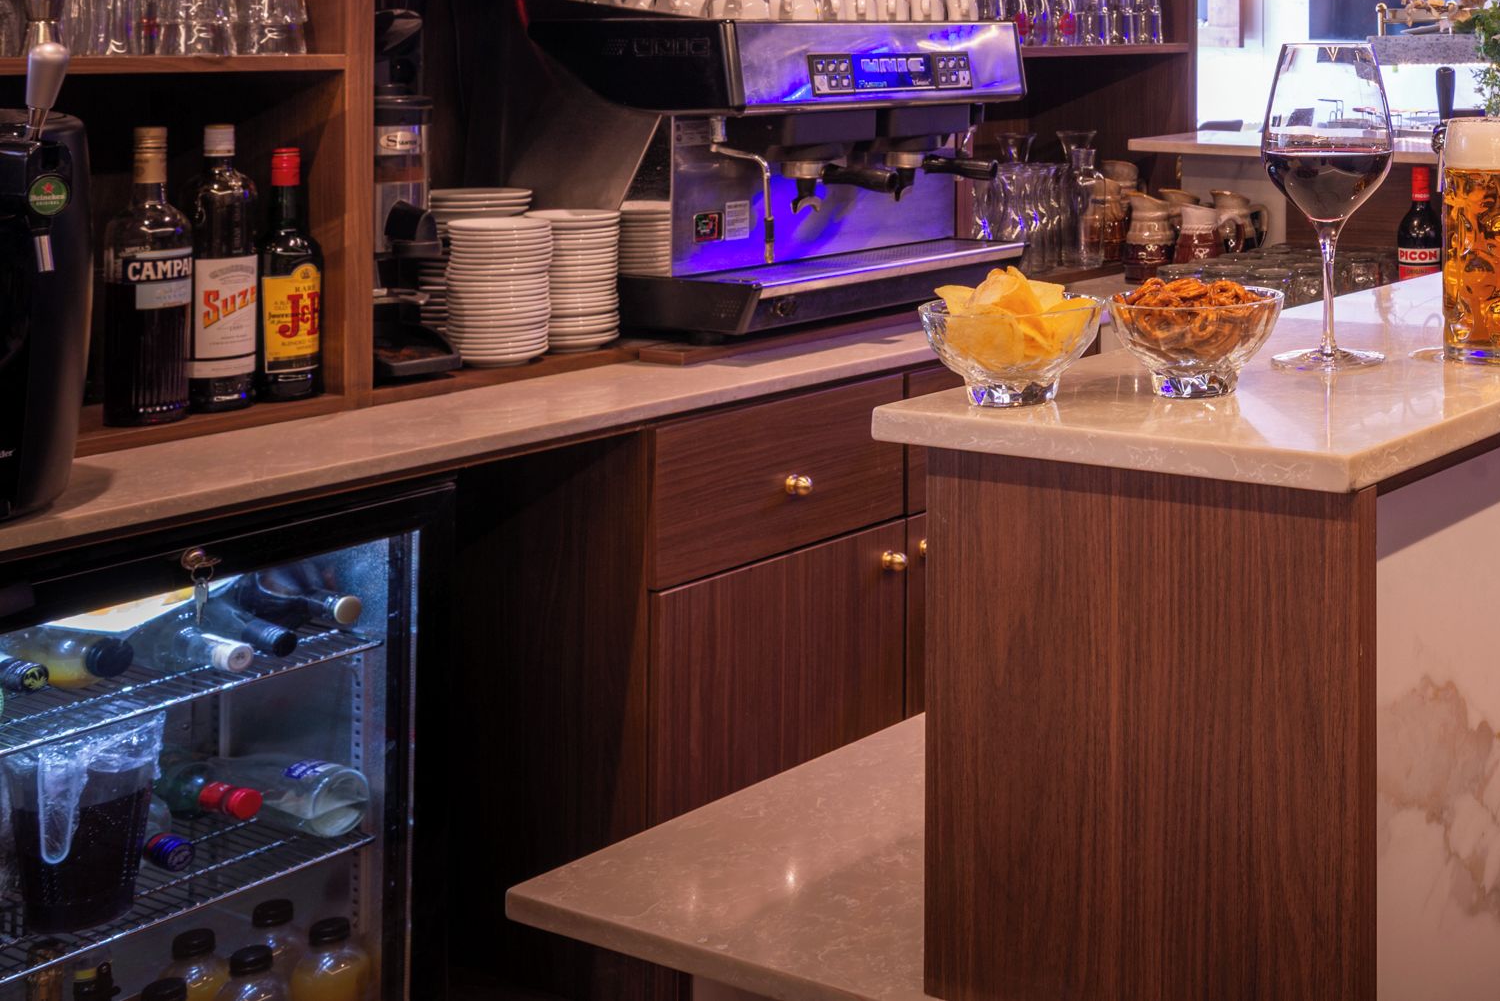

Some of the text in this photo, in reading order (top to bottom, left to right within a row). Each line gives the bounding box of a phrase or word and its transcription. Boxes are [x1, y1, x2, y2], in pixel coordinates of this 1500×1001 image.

[860, 57, 926, 73] UNIC
[1399, 249, 1438, 261] PICON
[127, 257, 192, 282] CAMPA
